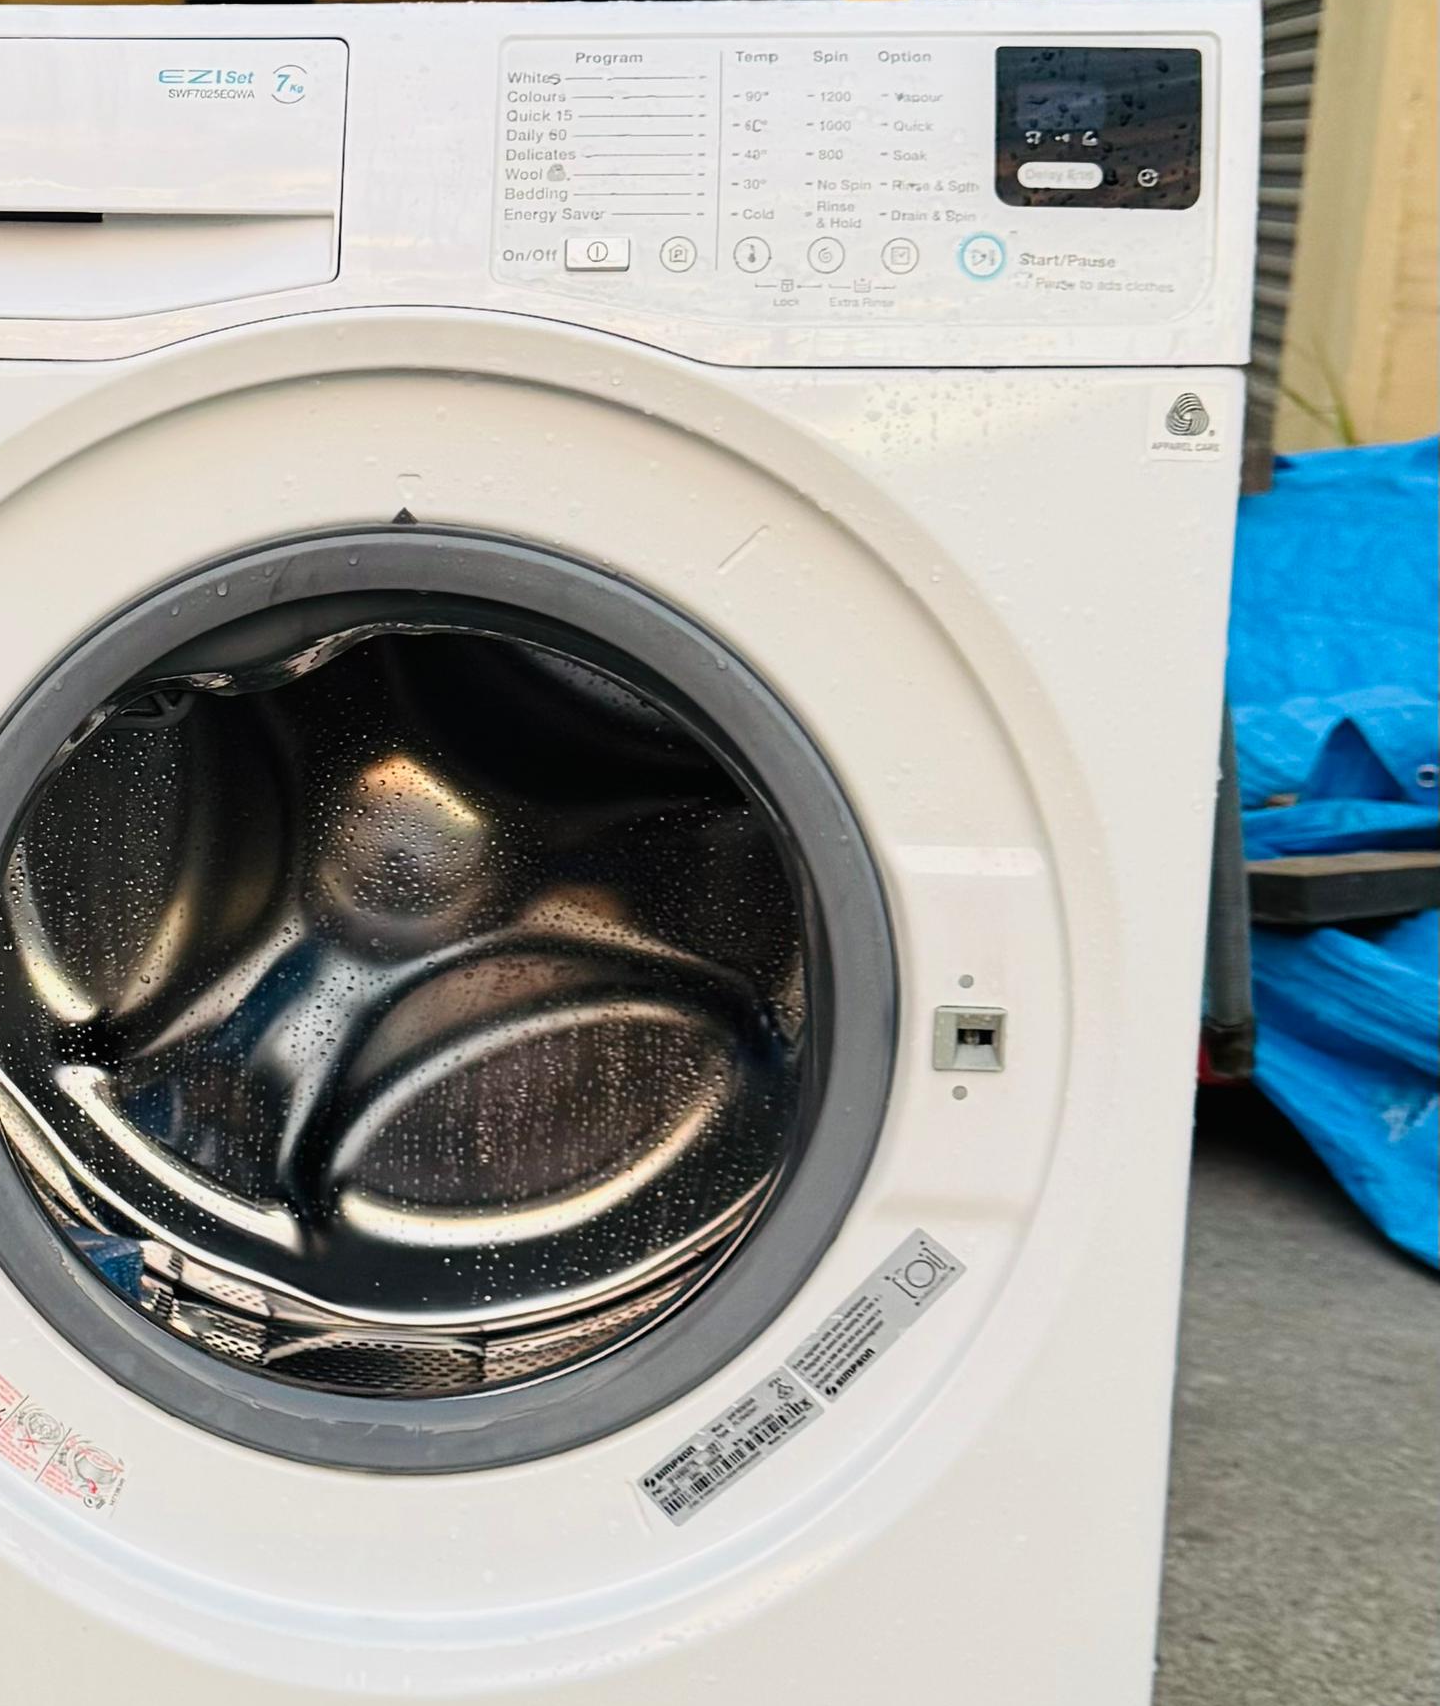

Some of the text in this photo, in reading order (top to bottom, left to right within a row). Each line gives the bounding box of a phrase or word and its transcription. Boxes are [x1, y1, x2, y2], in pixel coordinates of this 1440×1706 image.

[575, 52, 643, 65] Program
[736, 51, 778, 64] Temp
[813, 51, 848, 64] Spin
[878, 51, 932, 64] Option
[225, 71, 254, 84] Set
[276, 74, 304, 93] 7 Kg
[507, 72, 561, 85] Whites
[168, 89, 255, 99] SWF7025EQWA
[507, 91, 566, 103] Colours
[821, 92, 851, 102] 1200
[507, 110, 573, 122] Quick 15
[820, 121, 851, 132] 1000
[893, 121, 934, 132] Quick
[507, 129, 544, 143] Daily
[506, 149, 576, 161] Delicates
[819, 150, 843, 160] 800
[893, 150, 927, 161] Soak
[505, 168, 543, 180] Wool
[817, 180, 871, 192] No Spin
[932, 181, 944, 191] &
[505, 188, 568, 202] Bedding
[816, 202, 854, 212] Rinse
[504, 209, 604, 223] Energy Saver
[743, 209, 774, 220] Cold
[891, 211, 976, 223] Drain & Spin
[816, 218, 861, 229] & Hold
[503, 249, 557, 262] On/Off
[1019, 253, 1116, 268] Start/Pause
[1080, 279, 1093, 290] to
